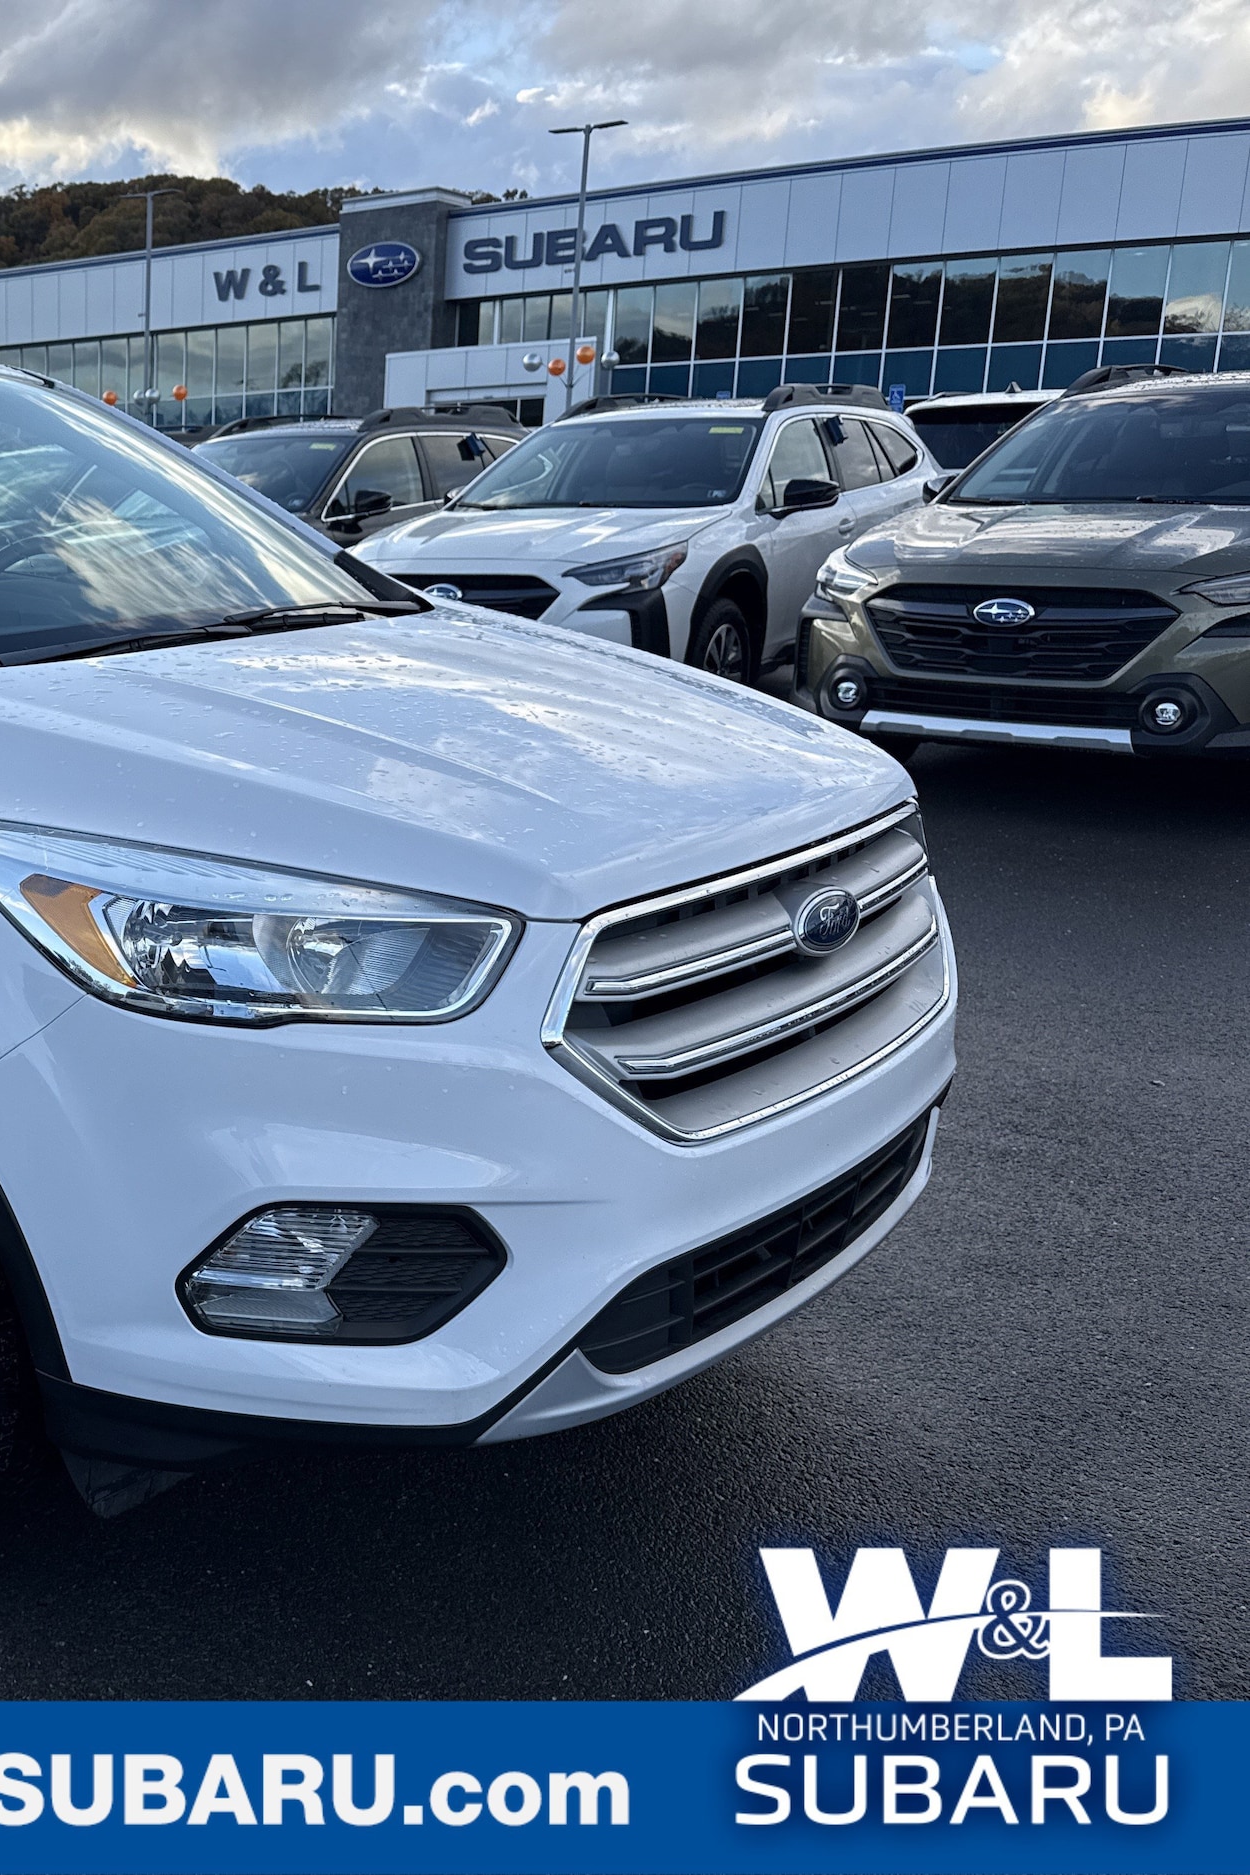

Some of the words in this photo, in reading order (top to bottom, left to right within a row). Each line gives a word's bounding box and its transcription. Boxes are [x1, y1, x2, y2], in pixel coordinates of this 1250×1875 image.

[463, 210, 726, 275] SUBARU
[213, 267, 252, 302] W
[258, 264, 287, 297] &
[297, 261, 321, 293] L
[819, 902, 851, 936] Ford
